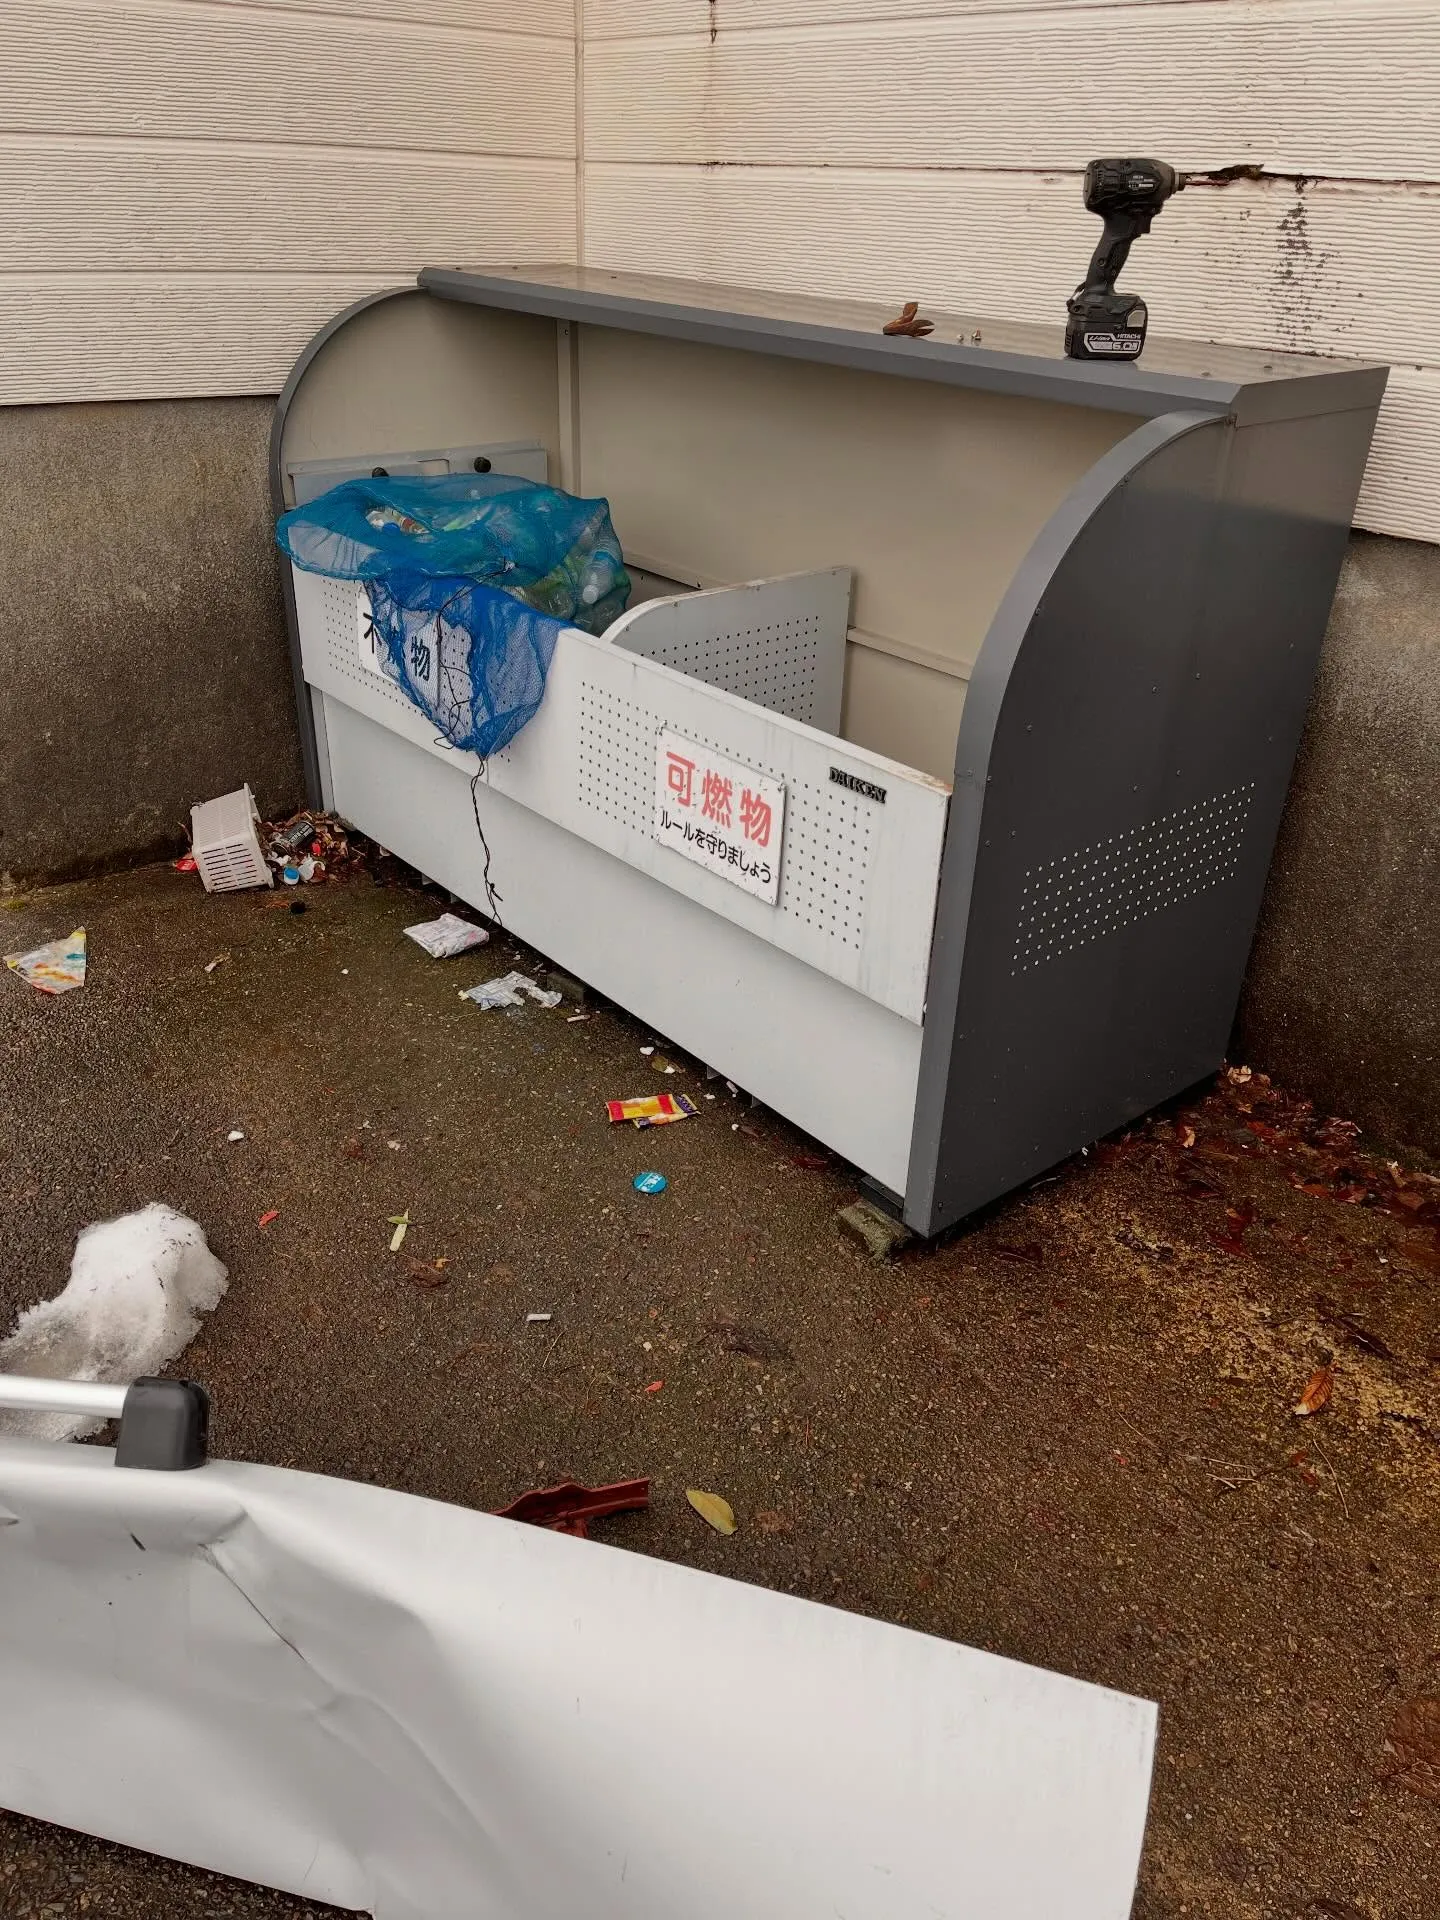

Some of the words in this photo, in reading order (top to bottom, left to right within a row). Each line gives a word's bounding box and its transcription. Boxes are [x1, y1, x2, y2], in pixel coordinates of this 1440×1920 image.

[362, 611, 431, 682] 不物
[665, 750, 772, 848] 可燃物
[829, 766, 887, 804] DAIKEN
[660, 809, 772, 884] ルールを守りましょう
